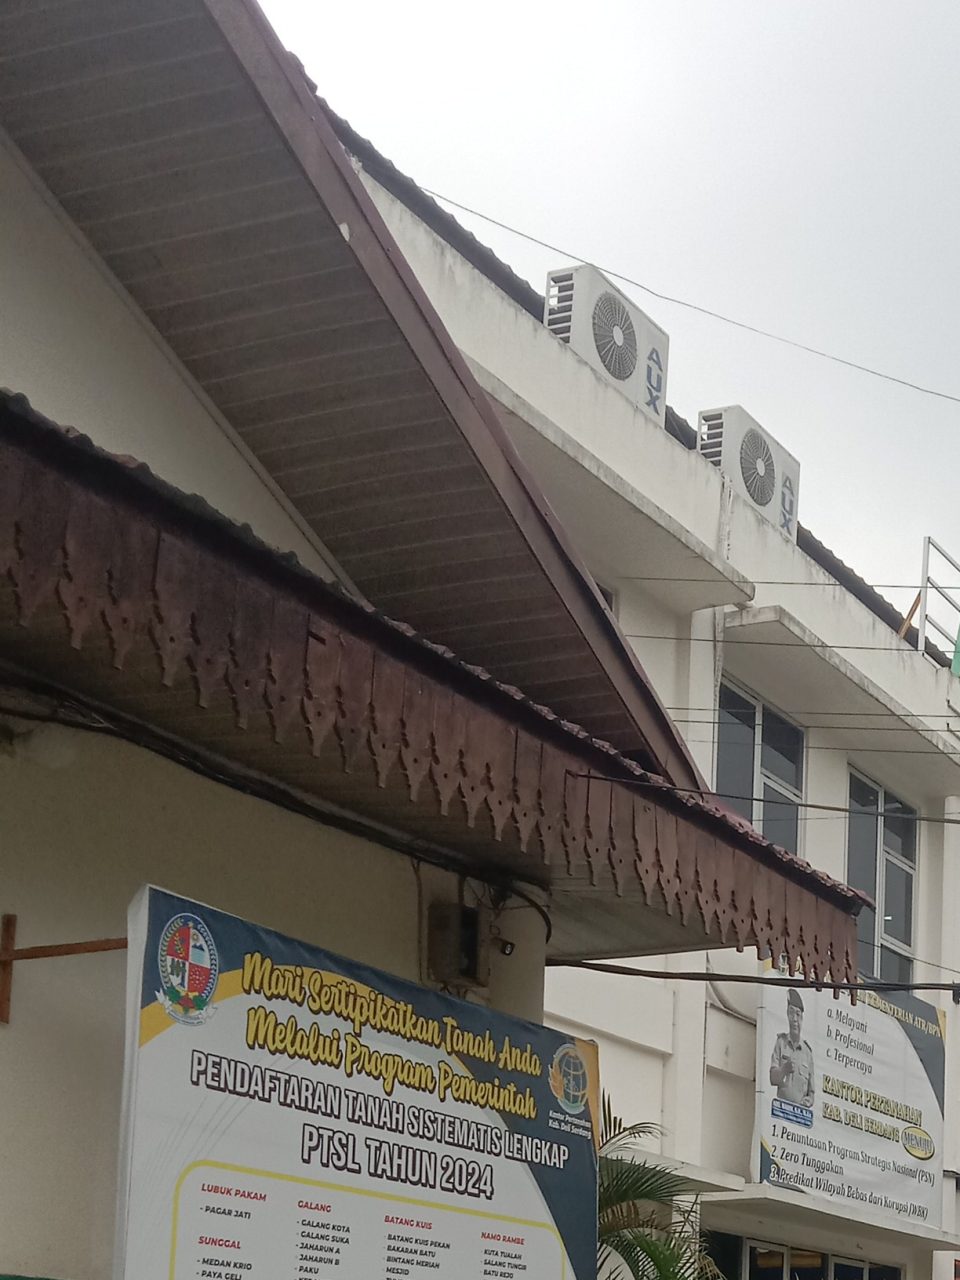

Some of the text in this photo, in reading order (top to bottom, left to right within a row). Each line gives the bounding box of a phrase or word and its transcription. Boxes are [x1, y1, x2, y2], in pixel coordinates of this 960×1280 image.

[646, 347, 663, 416] AUX
[780, 476, 794, 536] AUX
[242, 951, 542, 1076] Mari Sertipikatkan Tanah Anda
[836, 1008, 868, 1033] Melayani
[246, 1006, 537, 1119] Melalui Program Pemerintah
[834, 1048, 872, 1075] Terpercaya
[835, 1029, 874, 1056] Profesional
[190, 1050, 570, 1170] PENDAFTARAN TANAH SISTEMATIS LENGKAP
[822, 1073, 922, 1128] KANTOR PERTANAHAN
[822, 1101, 842, 1125] KAB.
[844, 1108, 863, 1130] DELI
[864, 1116, 900, 1144] SERDANG
[902, 1131, 934, 1156] MENUJU
[302, 1123, 494, 1199] PTSL TAHUN 2024
[771, 1145, 844, 1177] 2. Zero Tunggakan
[772, 1124, 935, 1188] 1. Penuntasan Program Strategis Nasional (PSN)
[201, 1183, 266, 1202] LUBUK PAKAM
[205, 1205, 251, 1219] PAGAR JATI
[298, 1200, 332, 1213] GALANG
[780, 1168, 814, 1190] Predikat
[815, 1177, 846, 1200] Wilayah
[846, 1186, 868, 1203] Bebas
[868, 1191, 884, 1207] dari
[884, 1195, 908, 1215] Korupsi
[908, 1200, 928, 1220] (WBK)
[198, 1236, 241, 1249] SUNGGAL
[384, 1215, 432, 1229] BATANG KUIS
[202, 1258, 252, 1270] MEDAN KRIO
